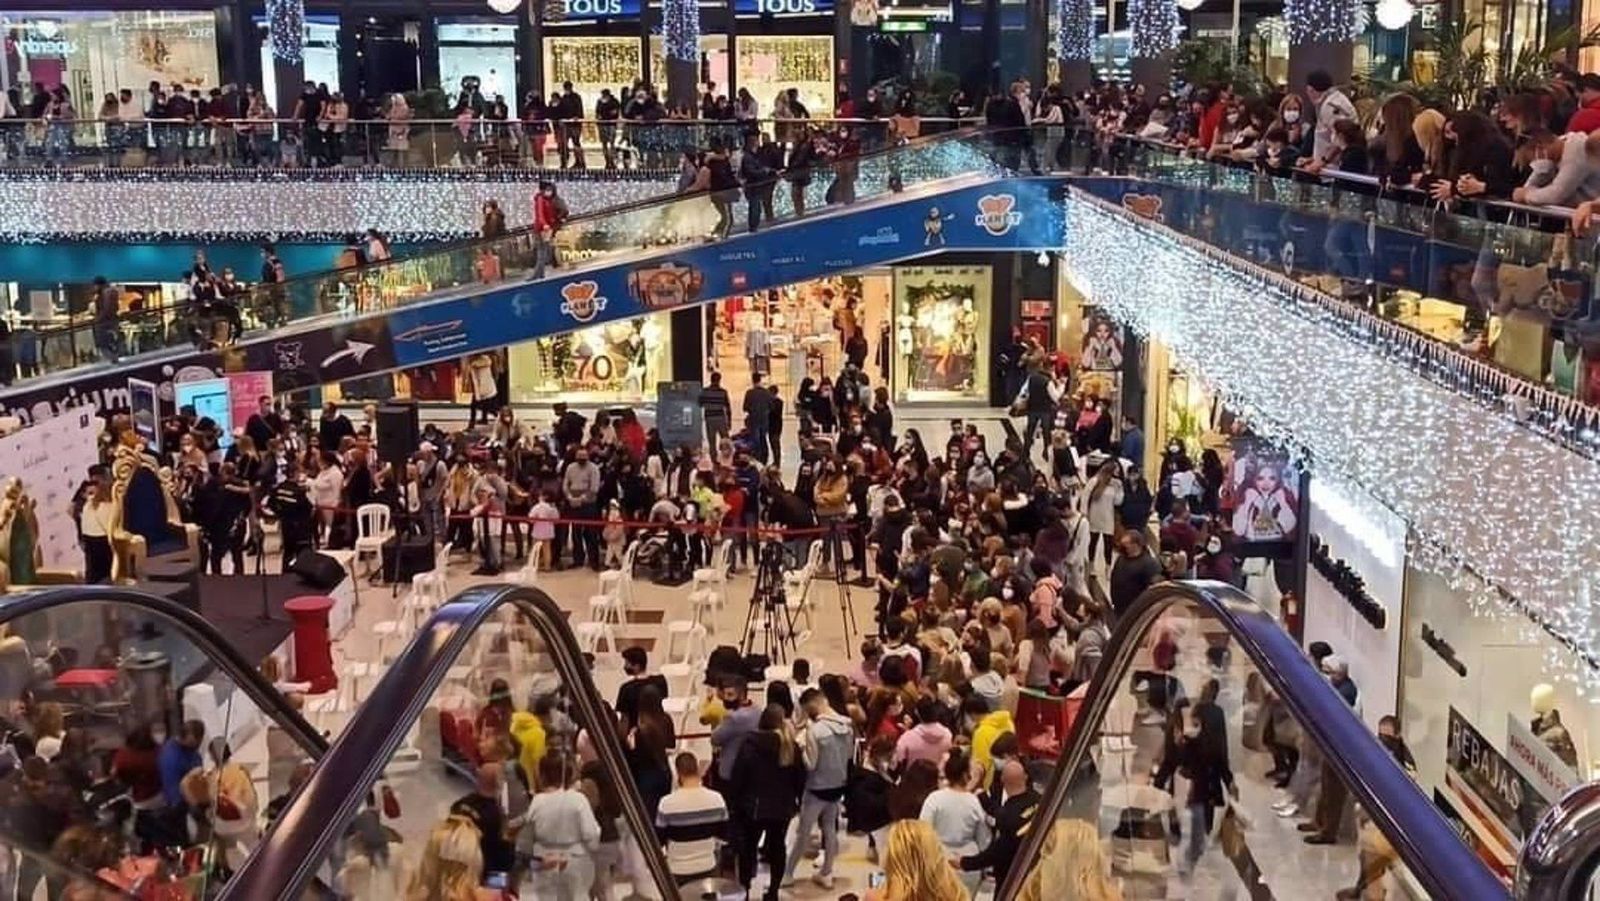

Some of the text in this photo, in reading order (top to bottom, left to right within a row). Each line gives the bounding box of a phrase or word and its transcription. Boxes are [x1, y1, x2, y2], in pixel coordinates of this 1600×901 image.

[562, 0, 622, 14] TOUS
[757, 0, 816, 13] TOUS
[1452, 719, 1520, 810] REBAJAS
